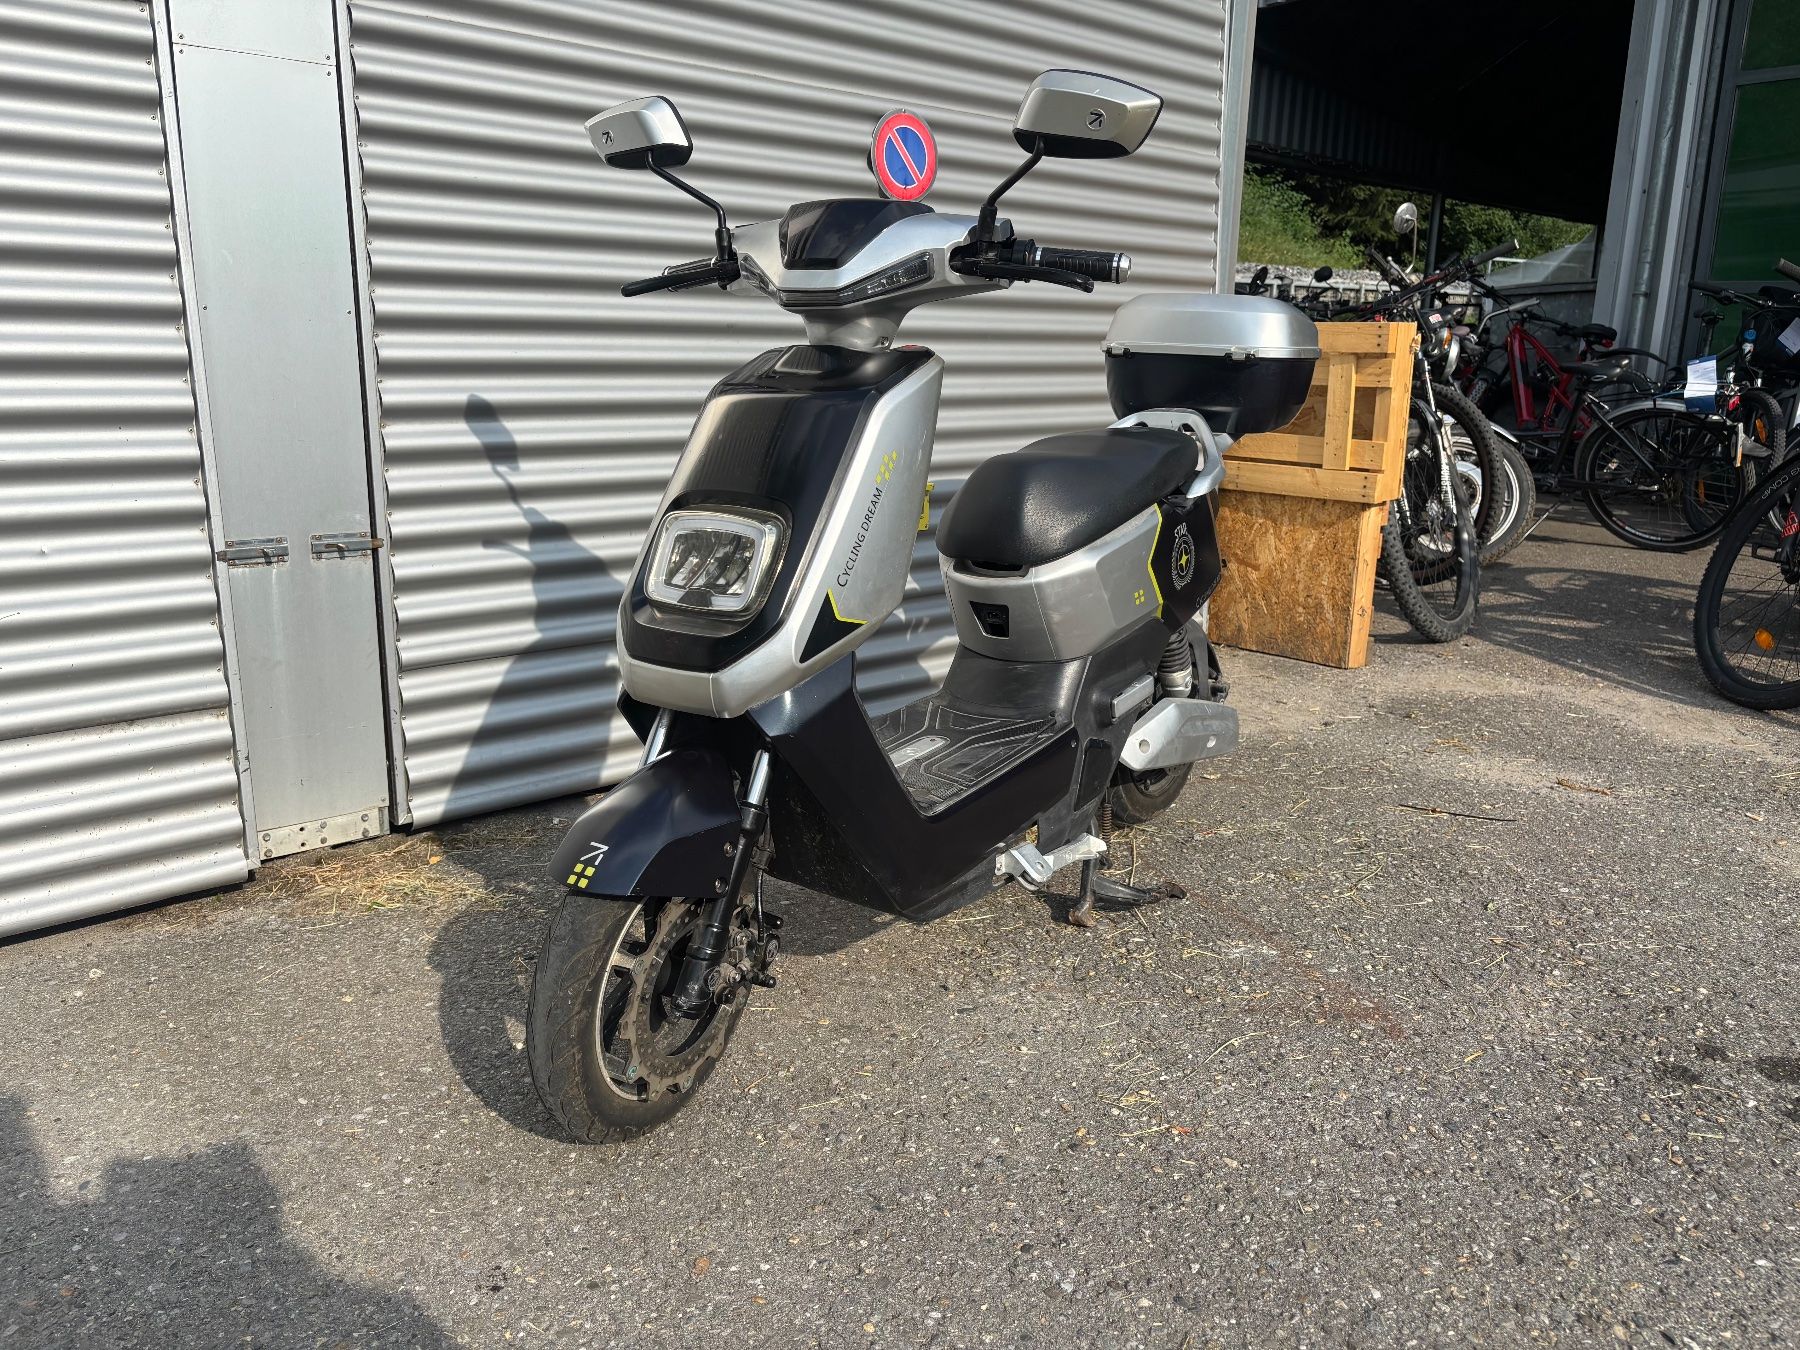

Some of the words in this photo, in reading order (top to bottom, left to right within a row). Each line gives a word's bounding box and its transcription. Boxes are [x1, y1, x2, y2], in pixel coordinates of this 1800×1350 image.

[1761, 475, 1789, 499] COMP
[837, 532, 866, 587] CYCLING
[861, 487, 883, 532] DREAM
